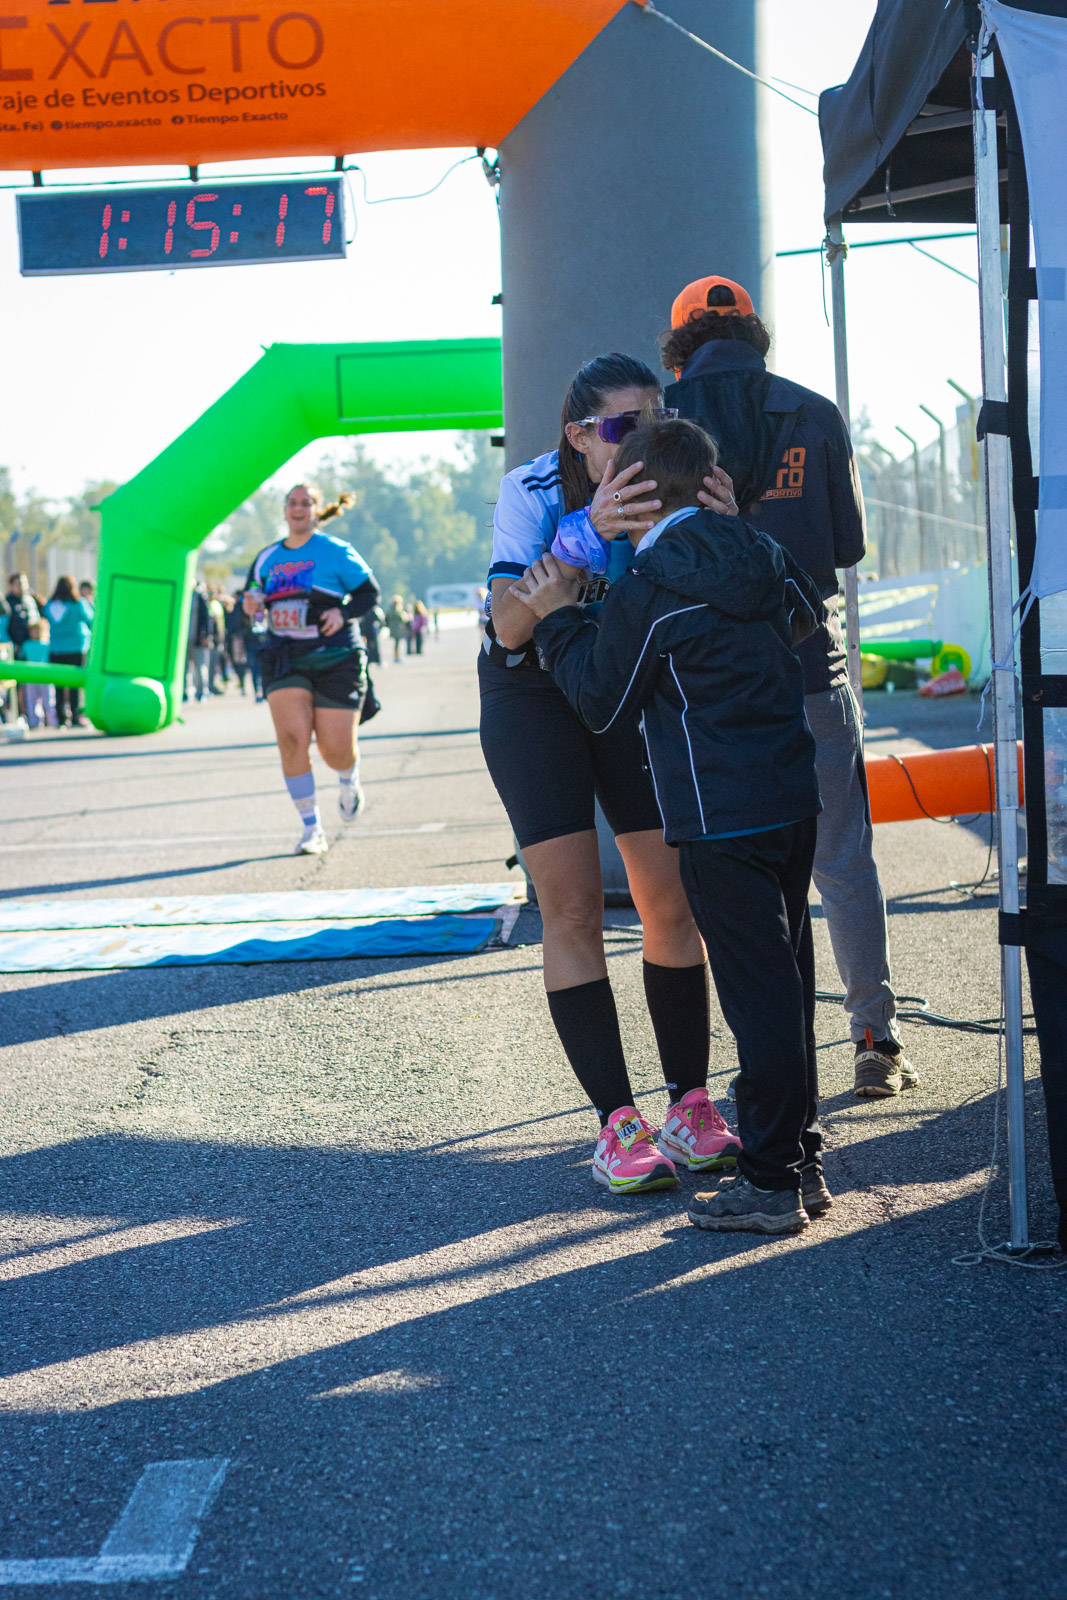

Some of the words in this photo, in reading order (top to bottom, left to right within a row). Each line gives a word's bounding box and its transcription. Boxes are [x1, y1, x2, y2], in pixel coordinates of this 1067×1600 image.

[0, 91, 38, 114] aje
[44, 88, 75, 108] de
[82, 87, 180, 107] Eventos
[188, 80, 326, 104] Deportivos
[187, 114, 239, 124] Tiempo
[242, 111, 288, 122] Exacto
[100, 186, 335, 258] 1:15:17
